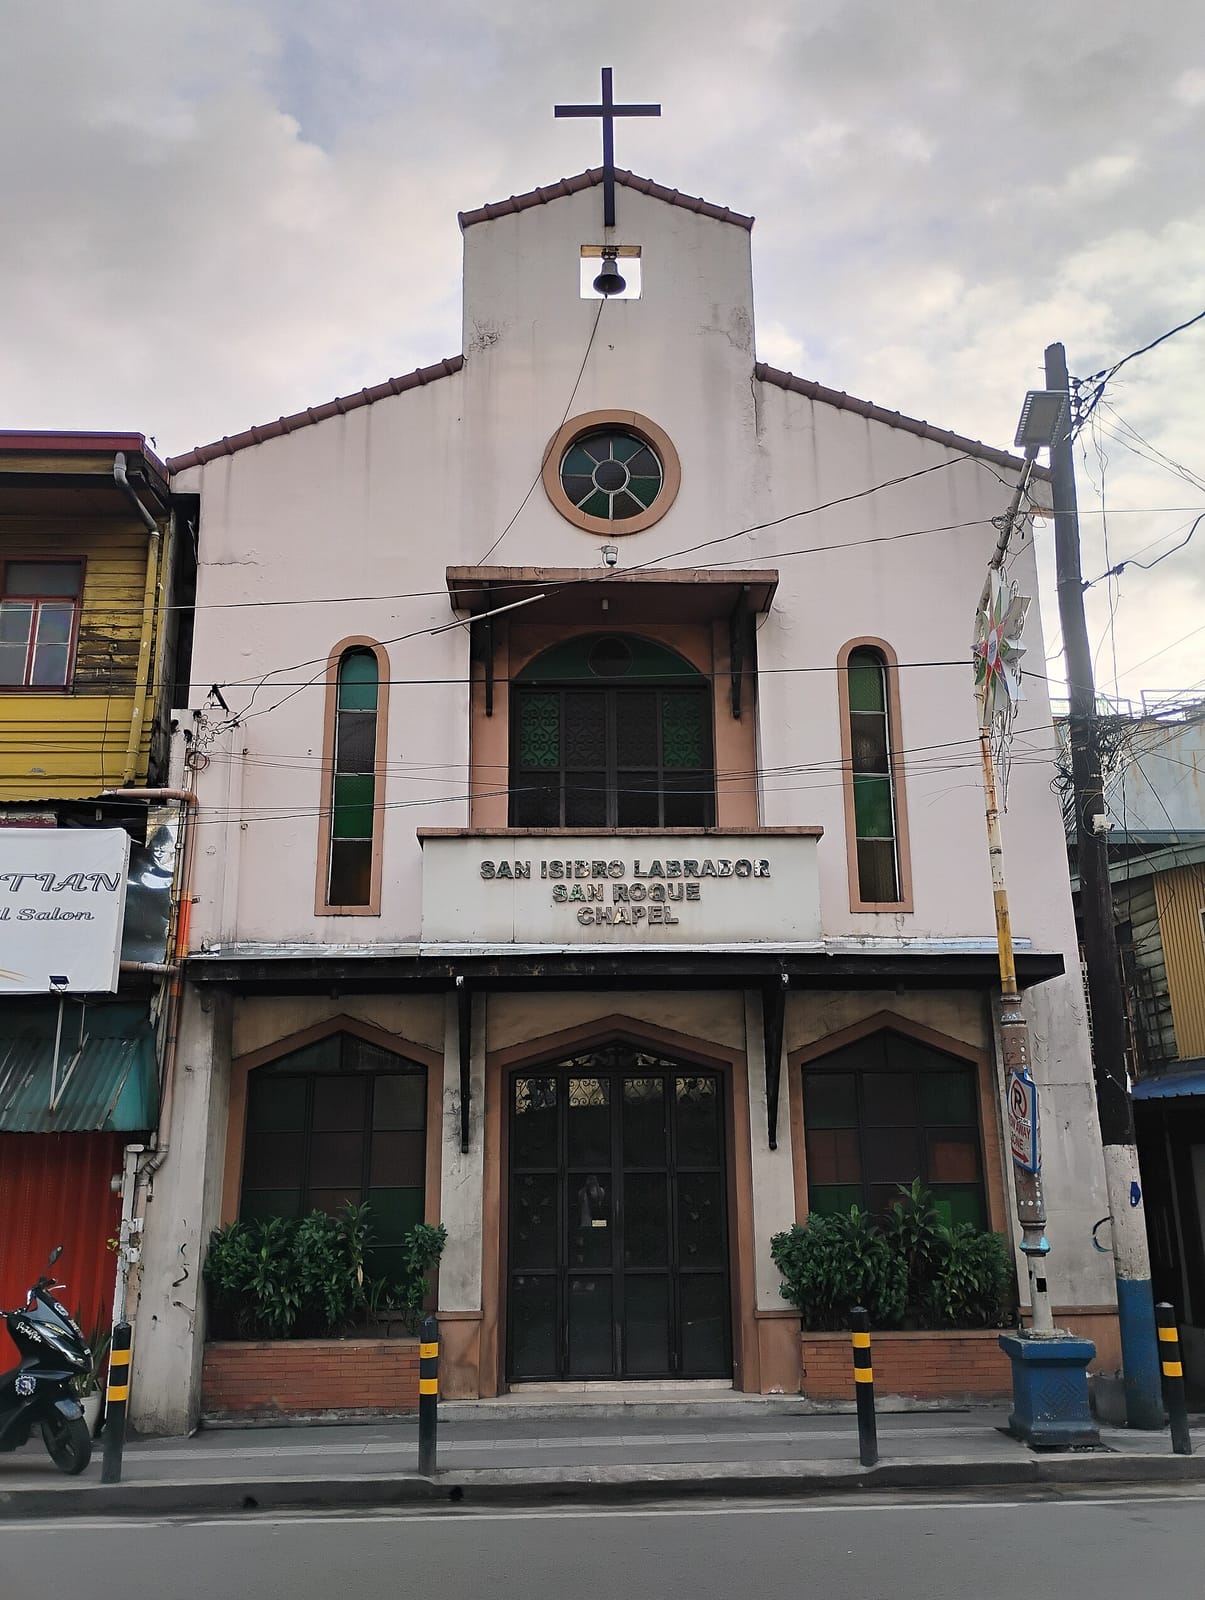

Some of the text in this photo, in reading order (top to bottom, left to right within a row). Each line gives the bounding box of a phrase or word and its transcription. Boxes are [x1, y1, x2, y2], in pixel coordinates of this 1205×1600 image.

[480, 859, 771, 879] SAN ISIDRO LABRADOR
[552, 882, 701, 903] SAN ROQUE
[16, 907, 95, 921] Salon
[577, 905, 680, 925] CHAPEL
